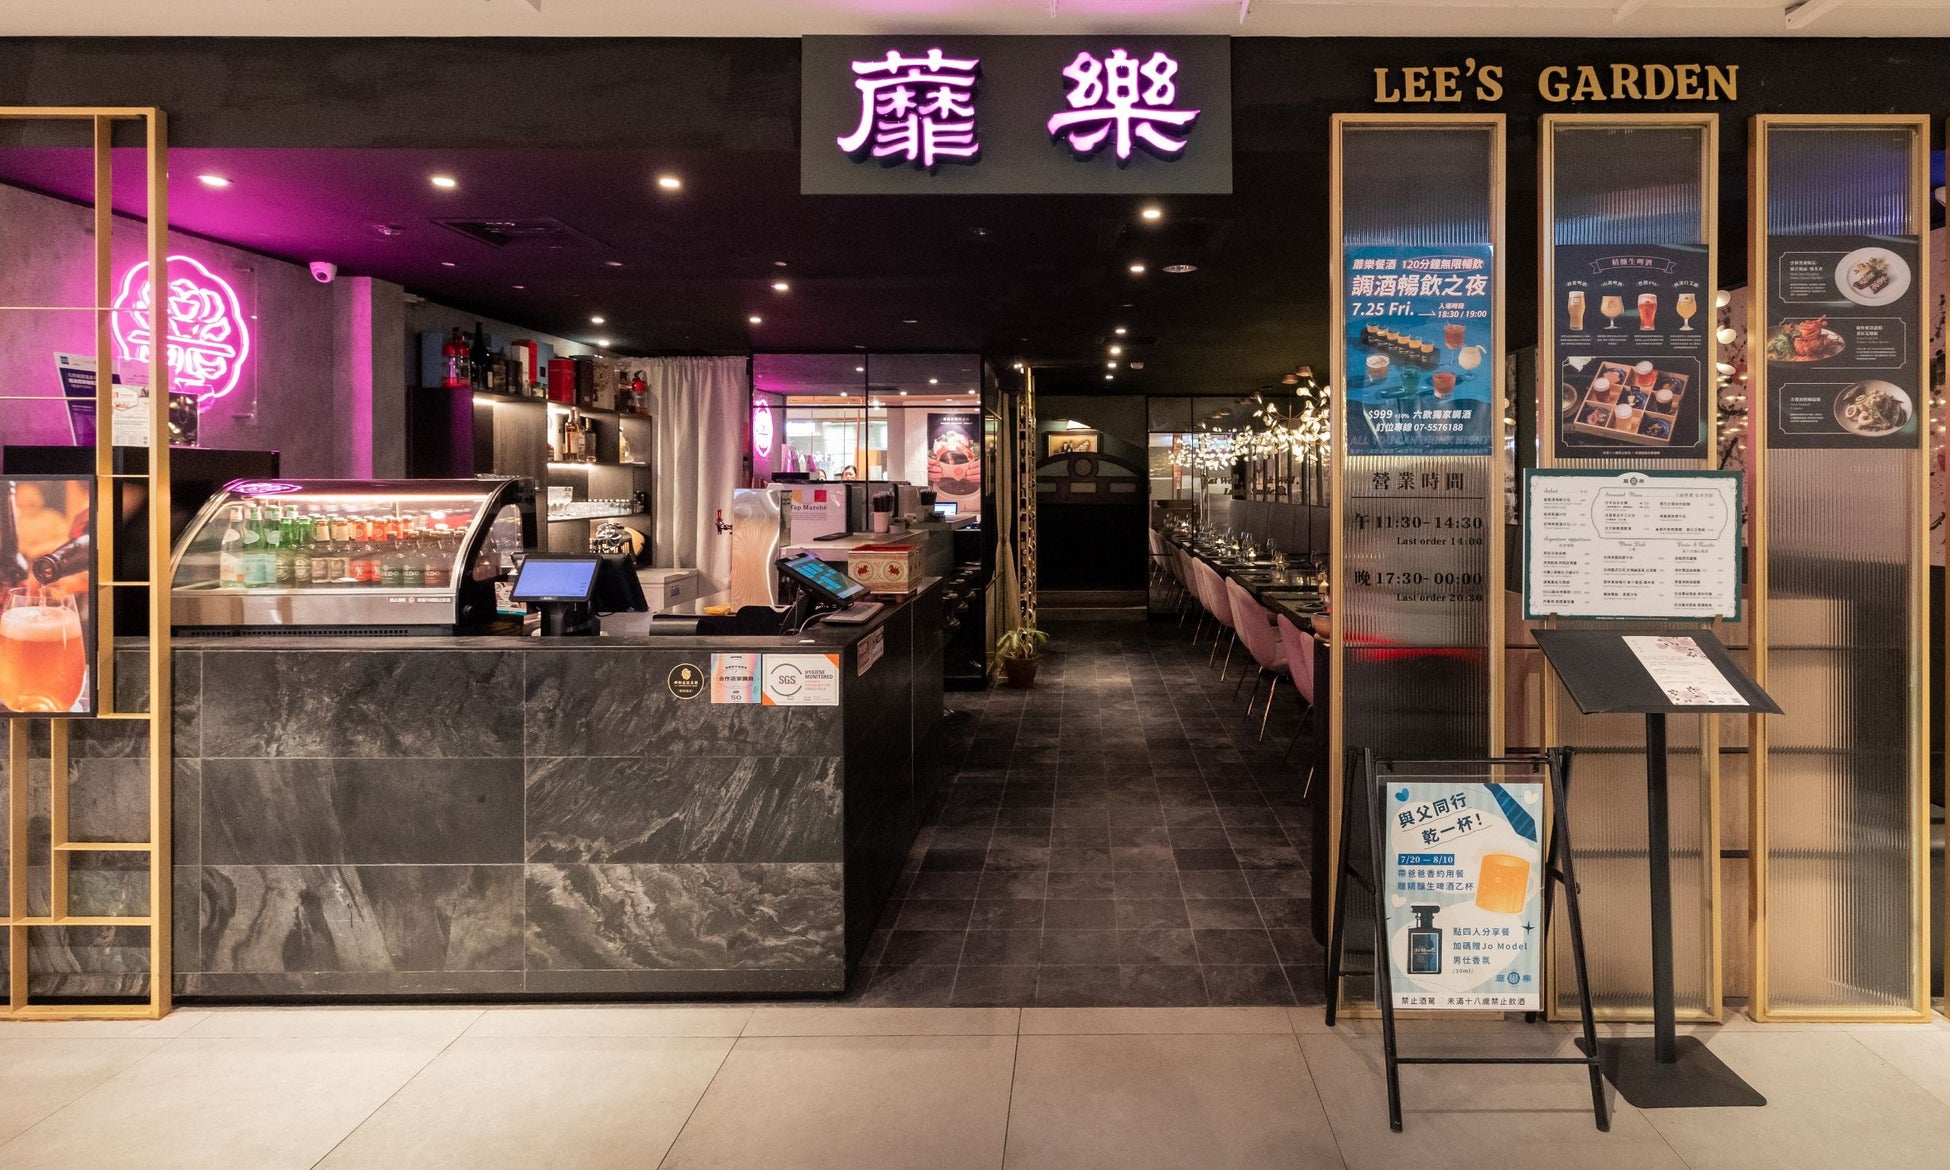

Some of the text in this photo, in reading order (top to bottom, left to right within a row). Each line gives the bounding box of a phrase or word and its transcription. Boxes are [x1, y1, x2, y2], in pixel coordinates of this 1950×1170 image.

[1373, 57, 1740, 103] LEE'S GARDEN
[1402, 258, 1484, 270] 120分鐘無限暢飲
[1351, 274, 1488, 297] 調酒暢飲之夜
[1352, 301, 1415, 316] 7.25 Fri.
[1438, 310, 1459, 318] 18:30
[1466, 310, 1487, 318] 19:00
[1368, 409, 1393, 419] $999
[1412, 409, 1472, 419] 六款獨家調酒
[1376, 422, 1464, 432] 訂位專線 07-5576188
[1372, 471, 1465, 490] 營業時間
[1397, 537, 1483, 545] Last order 14:00
[1397, 593, 1417, 602] Last
[1420, 593, 1446, 602] order
[778, 675, 796, 685] SGS
[1398, 792, 1468, 829] 與父同行
[1400, 855, 1421, 865] 7/20
[1432, 855, 1454, 865] 8/10
[1397, 869, 1464, 879] 帶爸爸香約用餐
[1453, 927, 1510, 936] 點四人分享餐
[1497, 942, 1528, 950] Model
[1401, 997, 1526, 1006] 禁止酒駕 未滿十八歲禁止飲酒
